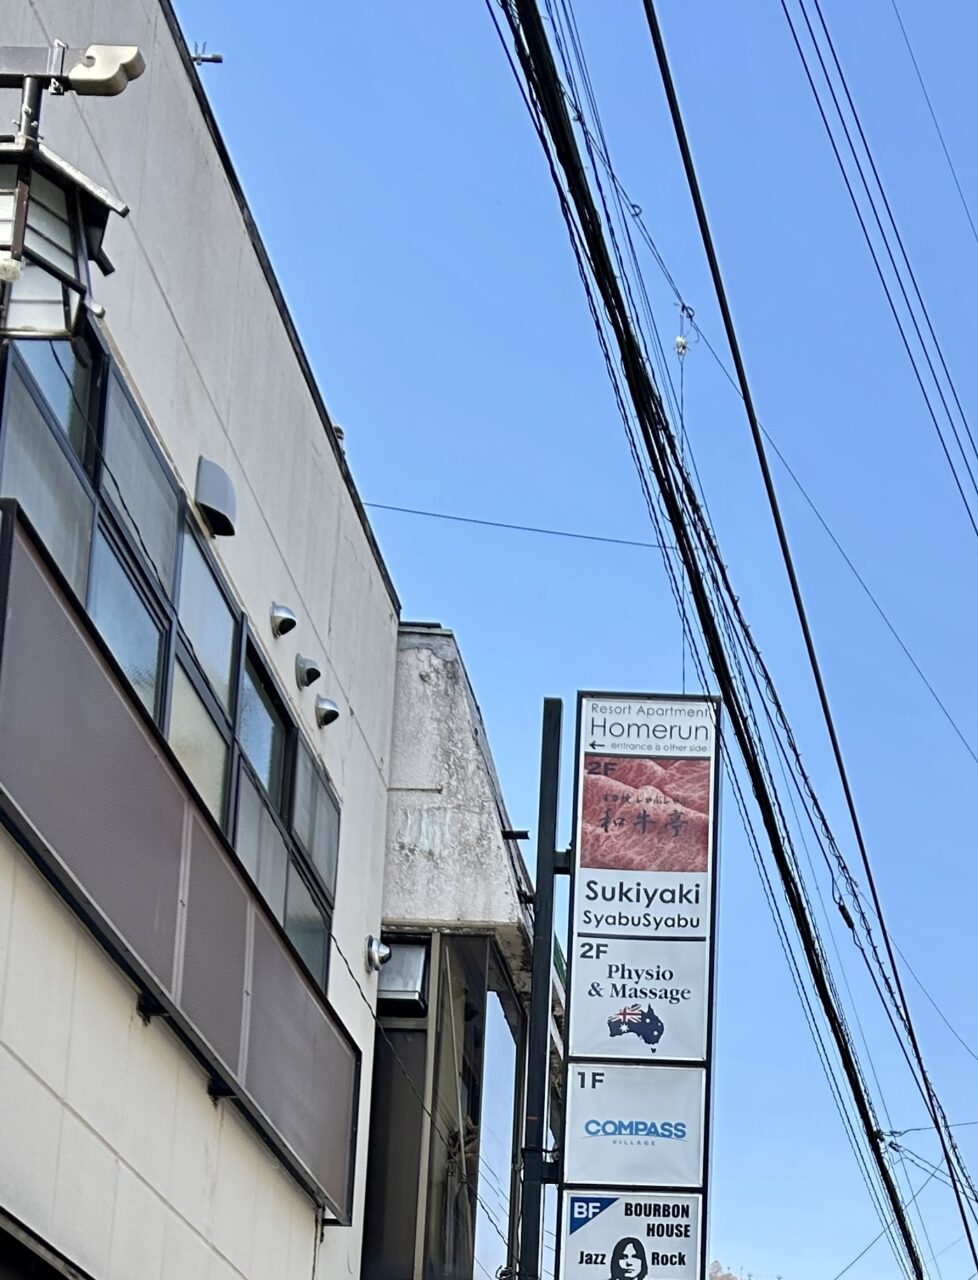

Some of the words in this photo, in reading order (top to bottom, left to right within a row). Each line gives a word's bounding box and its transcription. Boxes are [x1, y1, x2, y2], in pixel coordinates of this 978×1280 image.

[591, 702, 632, 715] Resort
[636, 704, 709, 719] Apartment
[591, 717, 709, 741] Homerun
[611, 742, 653, 751] entrance
[655, 743, 661, 751] is
[663, 744, 687, 752] other
[689, 744, 707, 753] side
[587, 761, 617, 776] 2F
[584, 879, 701, 909] Sukiyaki
[582, 910, 700, 931] SyabuSyabu
[579, 942, 609, 959] 2F
[606, 963, 674, 984] Physio
[587, 982, 604, 998] &
[609, 982, 692, 1005] Massage
[577, 1071, 605, 1089] 1F
[584, 1119, 687, 1139] COMPASS
[573, 1202, 601, 1218] BF
[624, 1202, 690, 1218] BOURBON
[646, 1223, 691, 1238] HOUSE
[578, 1251, 607, 1265] Jazz
[651, 1252, 687, 1266] Rock
